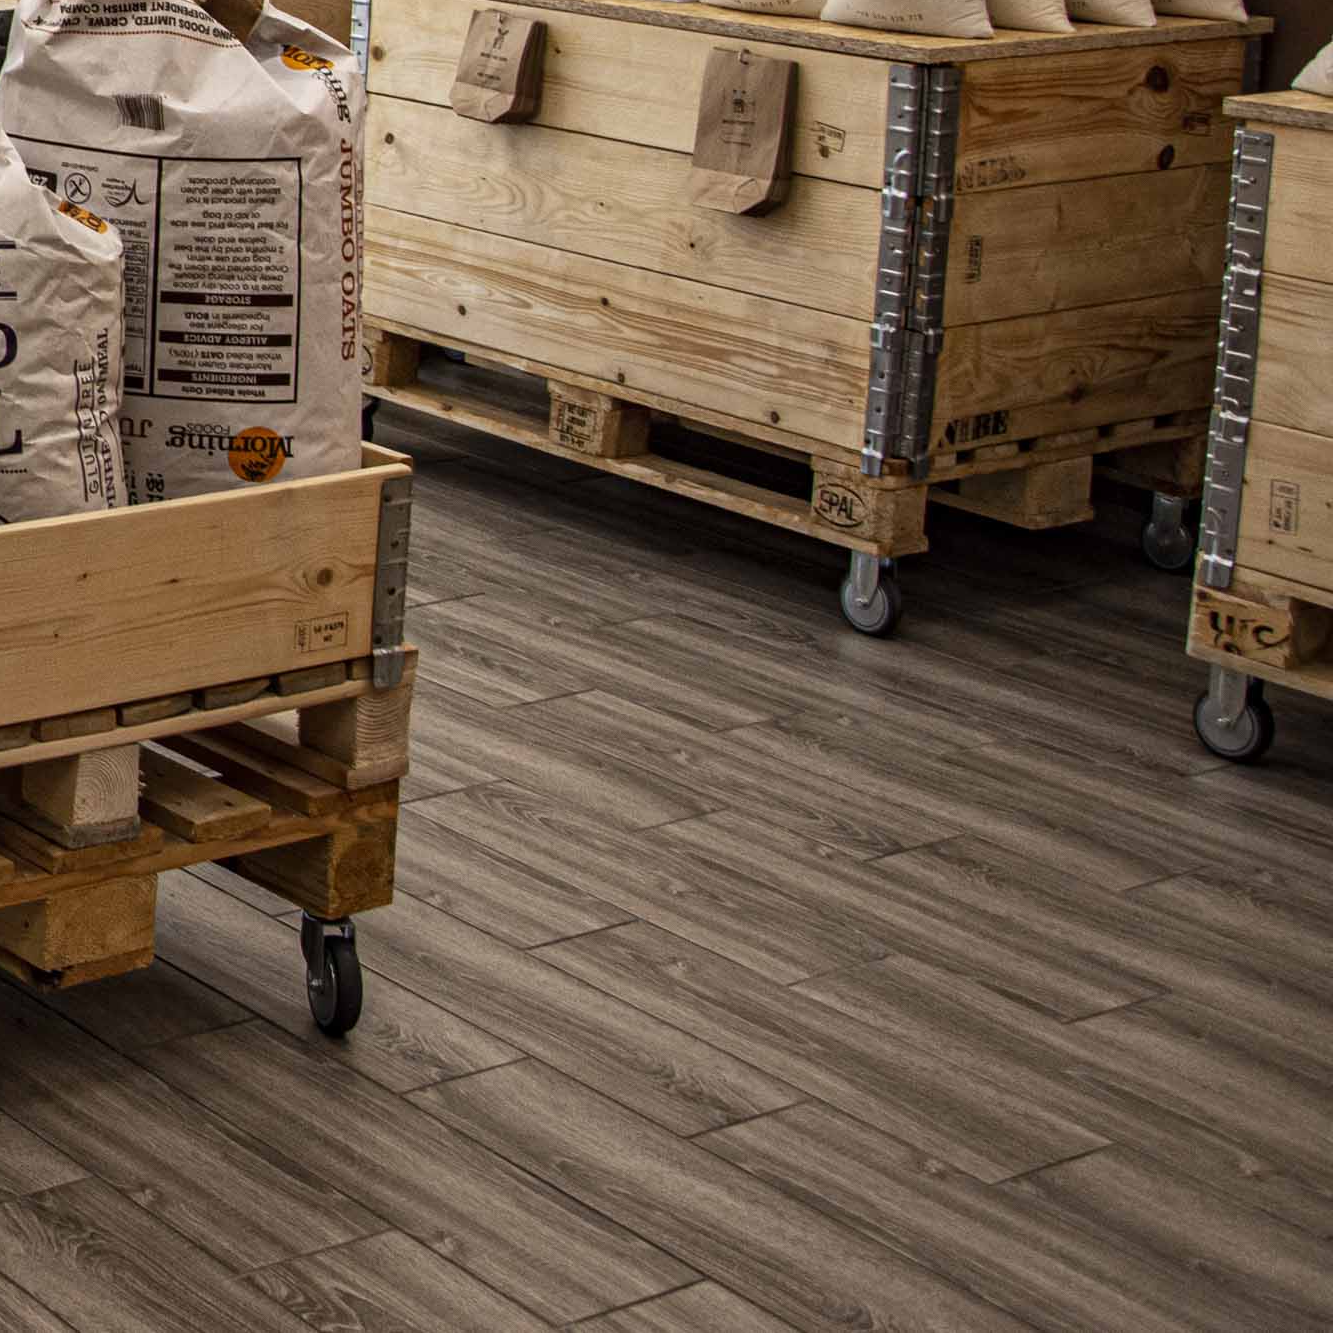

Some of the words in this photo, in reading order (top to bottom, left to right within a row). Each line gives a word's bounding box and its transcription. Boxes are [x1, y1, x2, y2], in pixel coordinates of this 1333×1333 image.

[59, 2, 100, 14] COMPA
[103, 2, 147, 14] BRITISH
[131, 14, 176, 29] LIMITED,
[179, 18, 210, 37] FOODS
[339, 138, 355, 263] JUMBO
[205, 295, 251, 304] STORAGE
[339, 271, 356, 362] OATS
[184, 334, 222, 343] ADVICE
[225, 335, 267, 344] ALLERGY
[191, 372, 257, 384] INGREDIENTS
[165, 425, 294, 458] Morning
